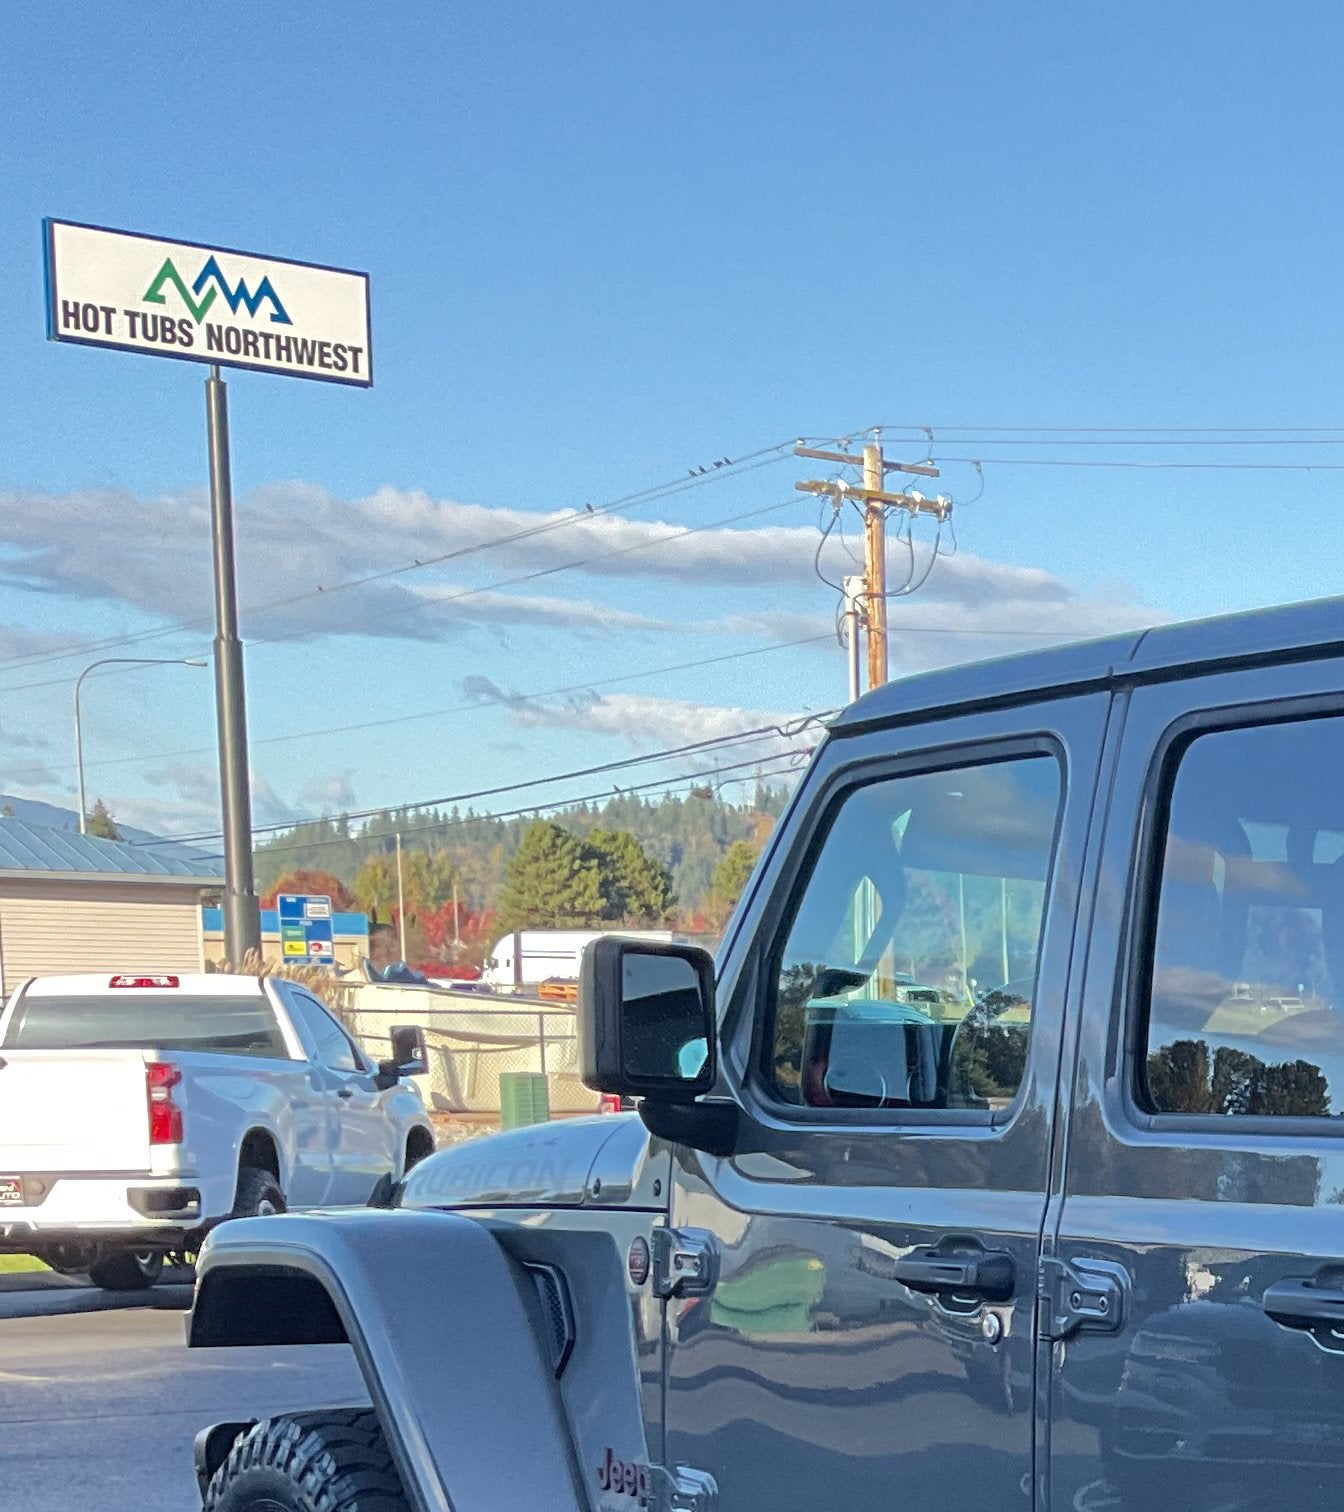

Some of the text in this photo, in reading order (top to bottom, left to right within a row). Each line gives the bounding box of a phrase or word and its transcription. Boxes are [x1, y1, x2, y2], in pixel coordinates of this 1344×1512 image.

[62, 299, 363, 373] HOT TUBS NORTHWEST
[597, 1447, 650, 1507] Jeep
